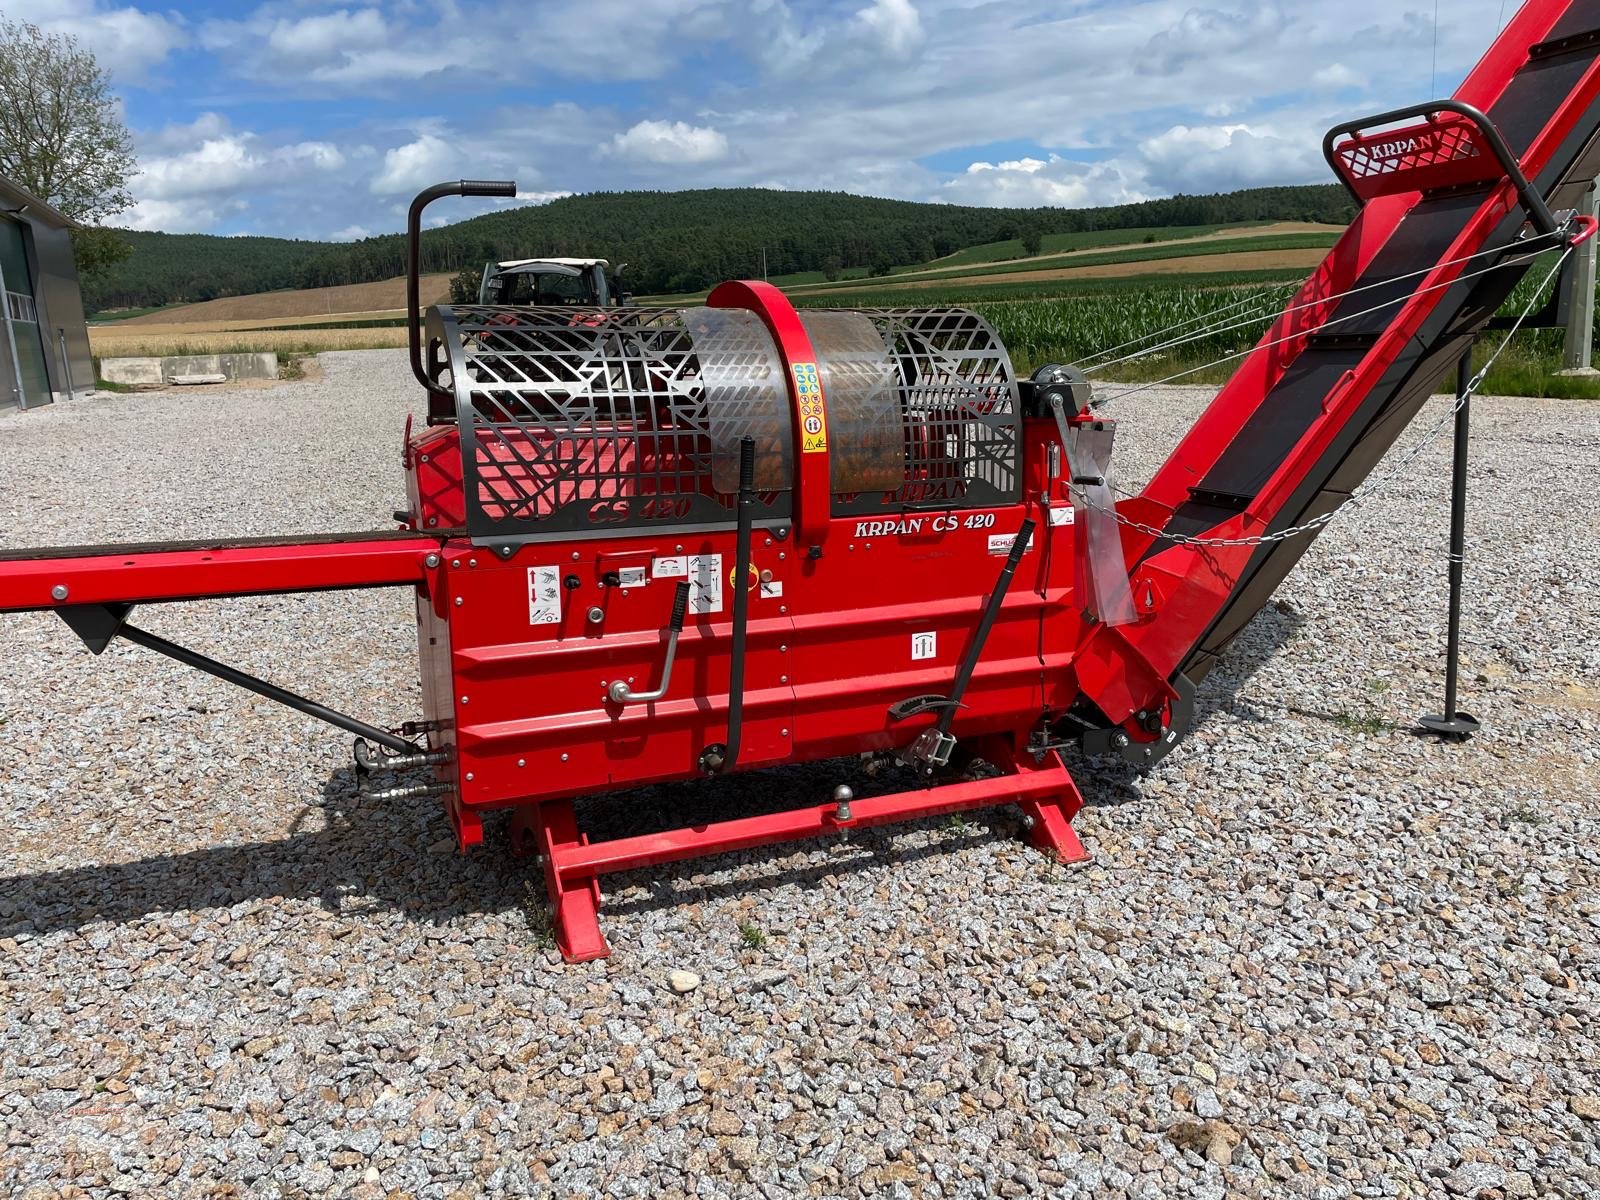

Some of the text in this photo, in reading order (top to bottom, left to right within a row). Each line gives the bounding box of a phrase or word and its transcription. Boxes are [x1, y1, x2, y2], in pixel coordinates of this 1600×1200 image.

[1371, 134, 1433, 159] KRPAN
[587, 497, 692, 523] CS 420
[932, 515, 959, 533] CS
[964, 513, 996, 530] 420
